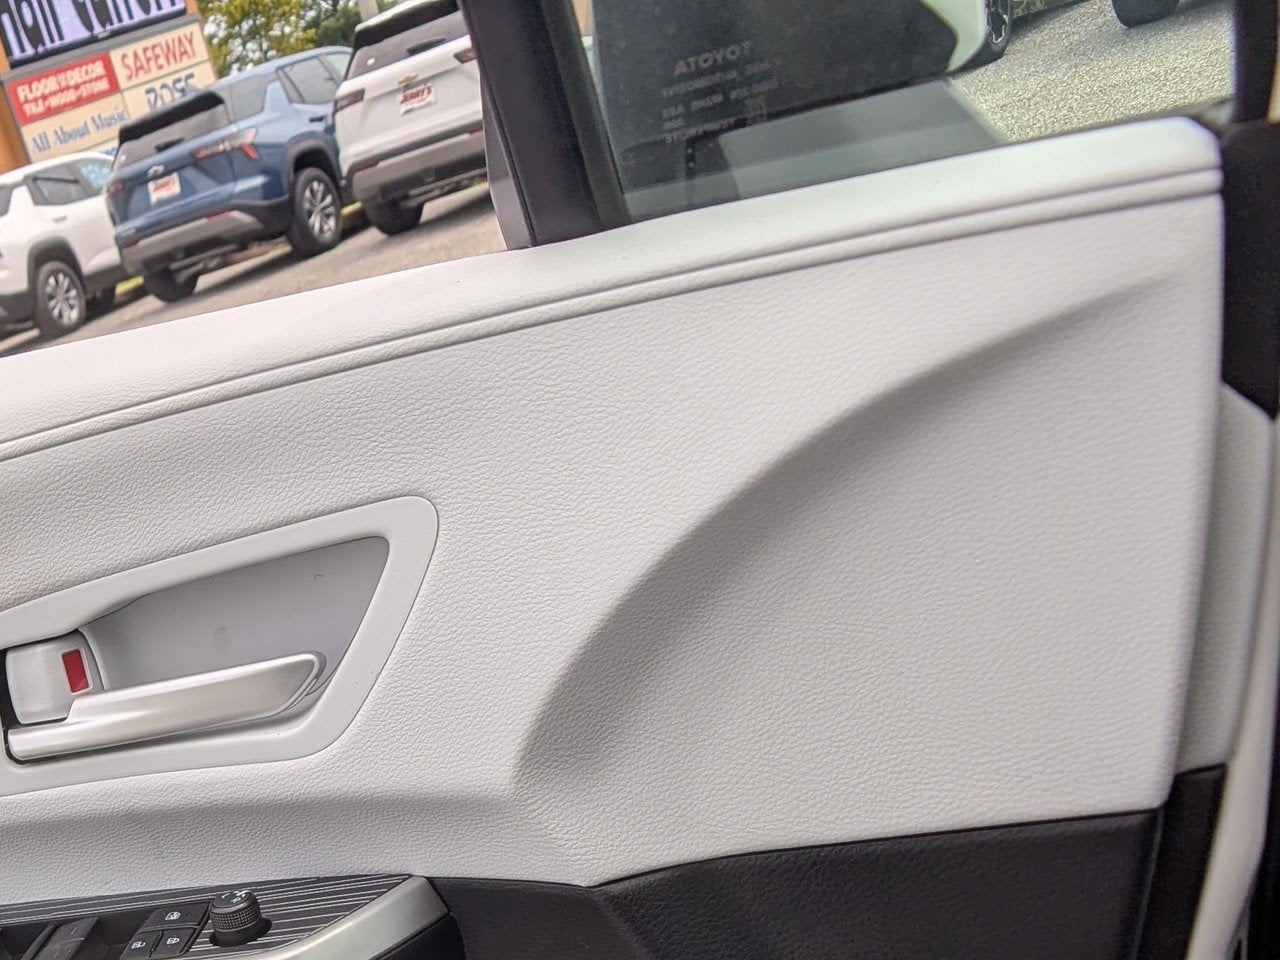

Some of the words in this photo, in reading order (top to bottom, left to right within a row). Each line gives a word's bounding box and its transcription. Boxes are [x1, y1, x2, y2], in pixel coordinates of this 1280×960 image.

[120, 30, 198, 80] SAFEWAY
[16, 75, 59, 104] FLOOR
[66, 59, 107, 87] DECOR
[31, 130, 51, 152] All
[53, 124, 90, 144] About
